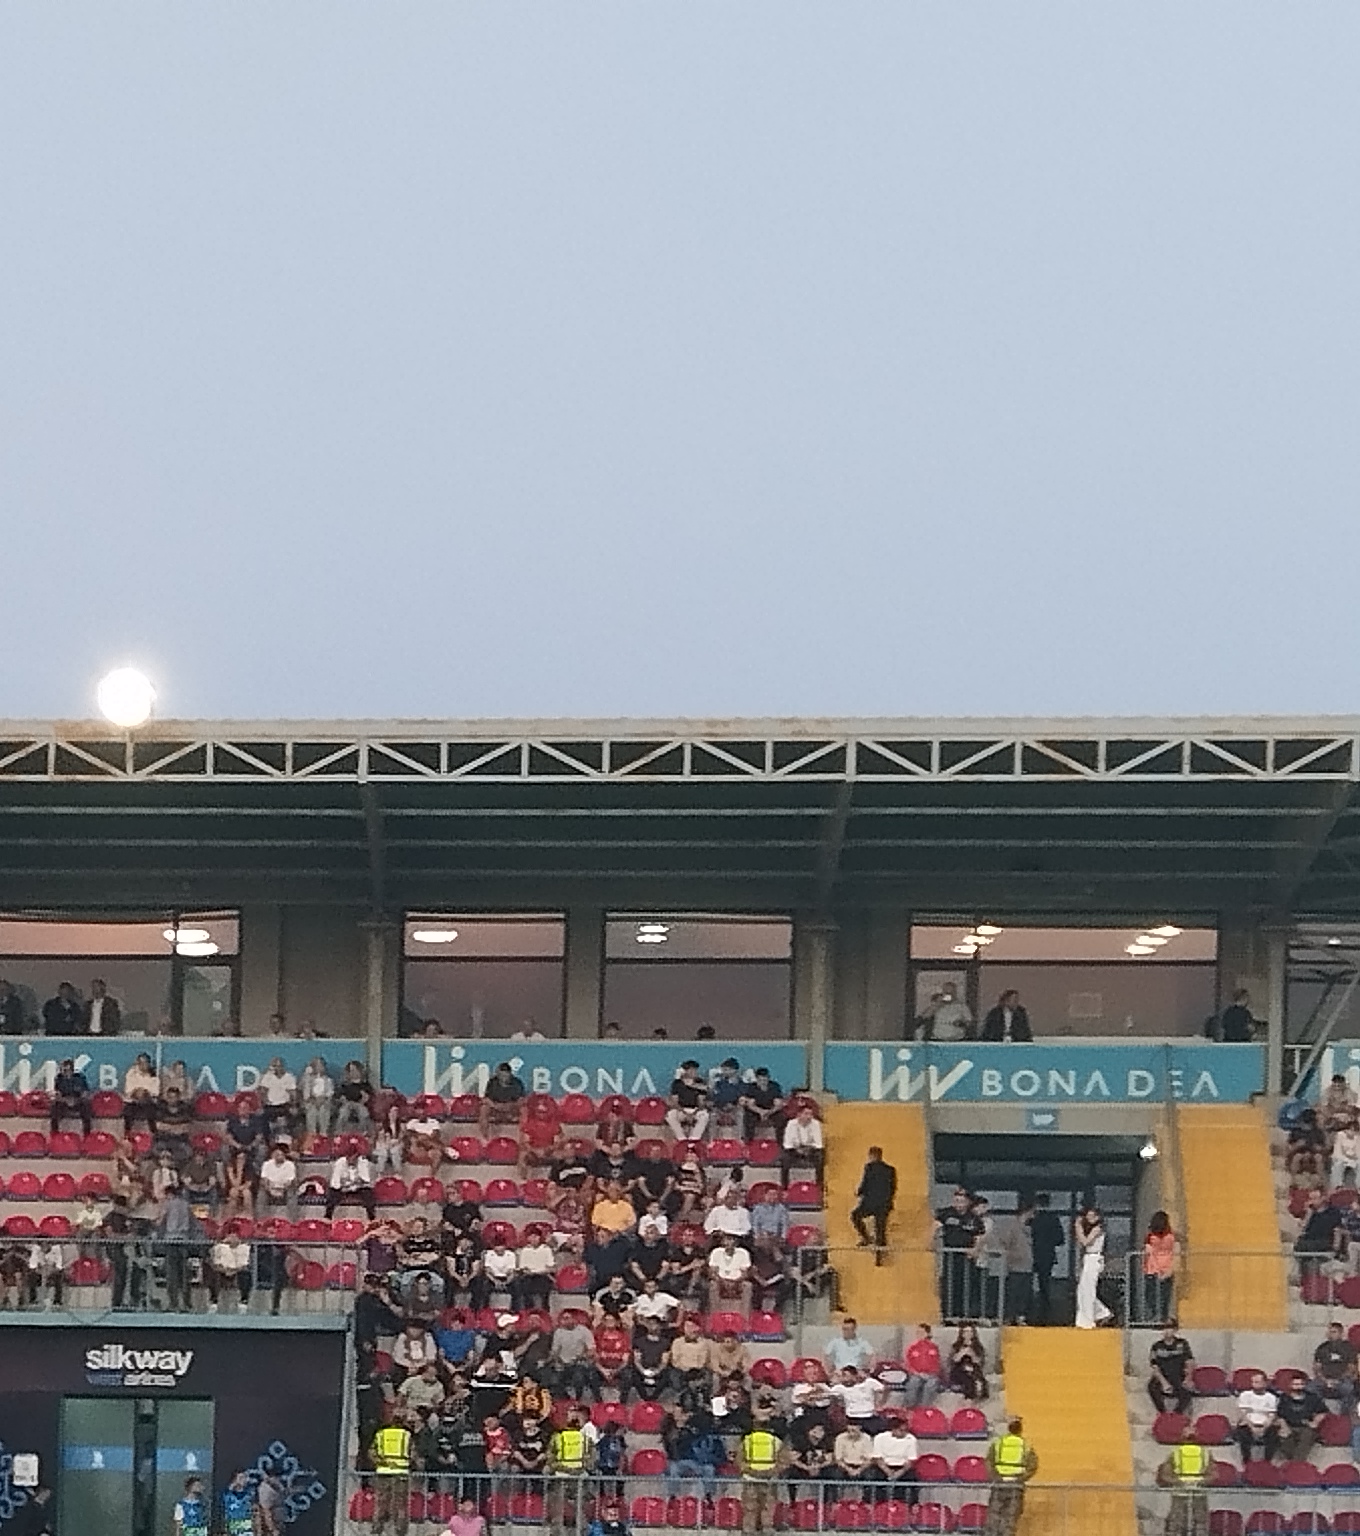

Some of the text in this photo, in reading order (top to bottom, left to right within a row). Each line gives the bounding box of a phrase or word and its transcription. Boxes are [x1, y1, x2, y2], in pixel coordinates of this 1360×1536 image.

[532, 1066, 657, 1094] BONA
[982, 1069, 1111, 1097] BONA
[1128, 1070, 1220, 1098] DEA
[85, 1343, 194, 1376] silkway
